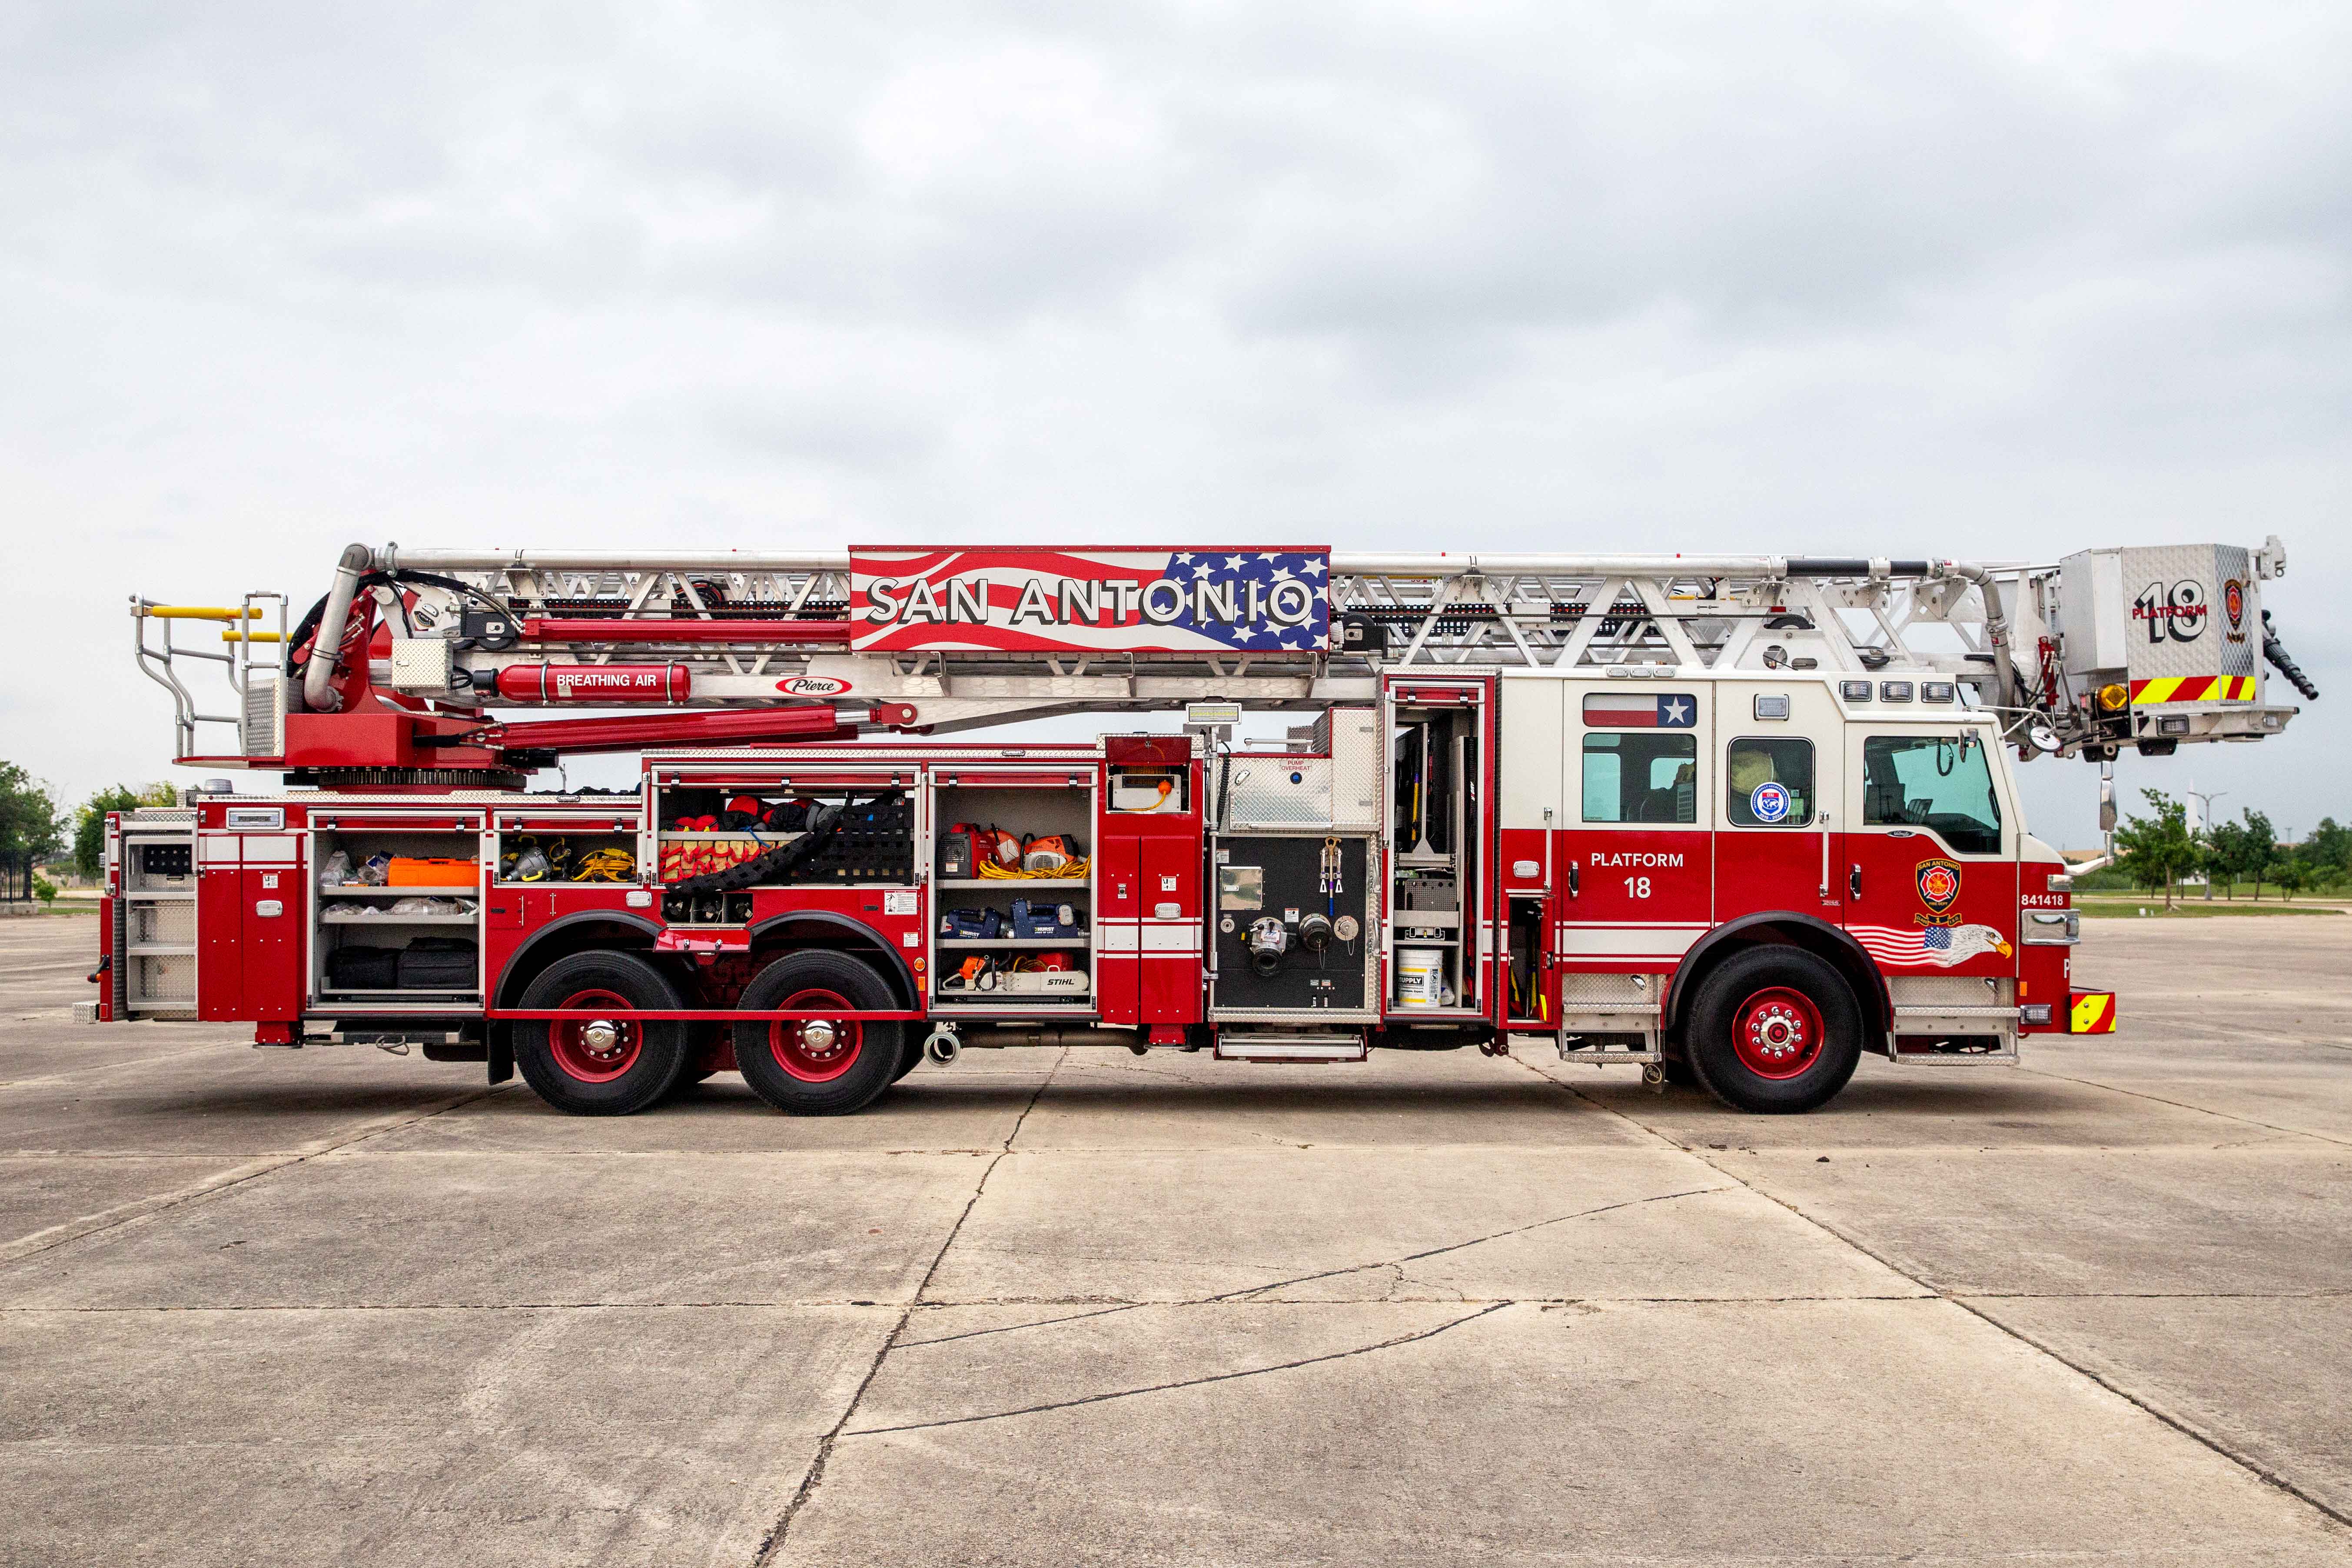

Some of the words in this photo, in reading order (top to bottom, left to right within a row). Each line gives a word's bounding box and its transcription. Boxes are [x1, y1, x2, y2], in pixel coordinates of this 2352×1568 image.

[866, 577, 988, 625] SAN
[1009, 577, 1316, 625] ANTONIO
[2132, 605, 2207, 620] PLATFORM
[2134, 579, 2206, 643] 18
[557, 674, 630, 686] BREATHING
[635, 674, 657, 686] AIR
[792, 679, 835, 692] Pierce
[1591, 853, 1683, 867] PLATFORM
[1918, 862, 1930, 870] SAN
[1932, 861, 1959, 870] ANTONIO
[1624, 877, 1651, 898] 18
[2021, 894, 2063, 906] 841418
